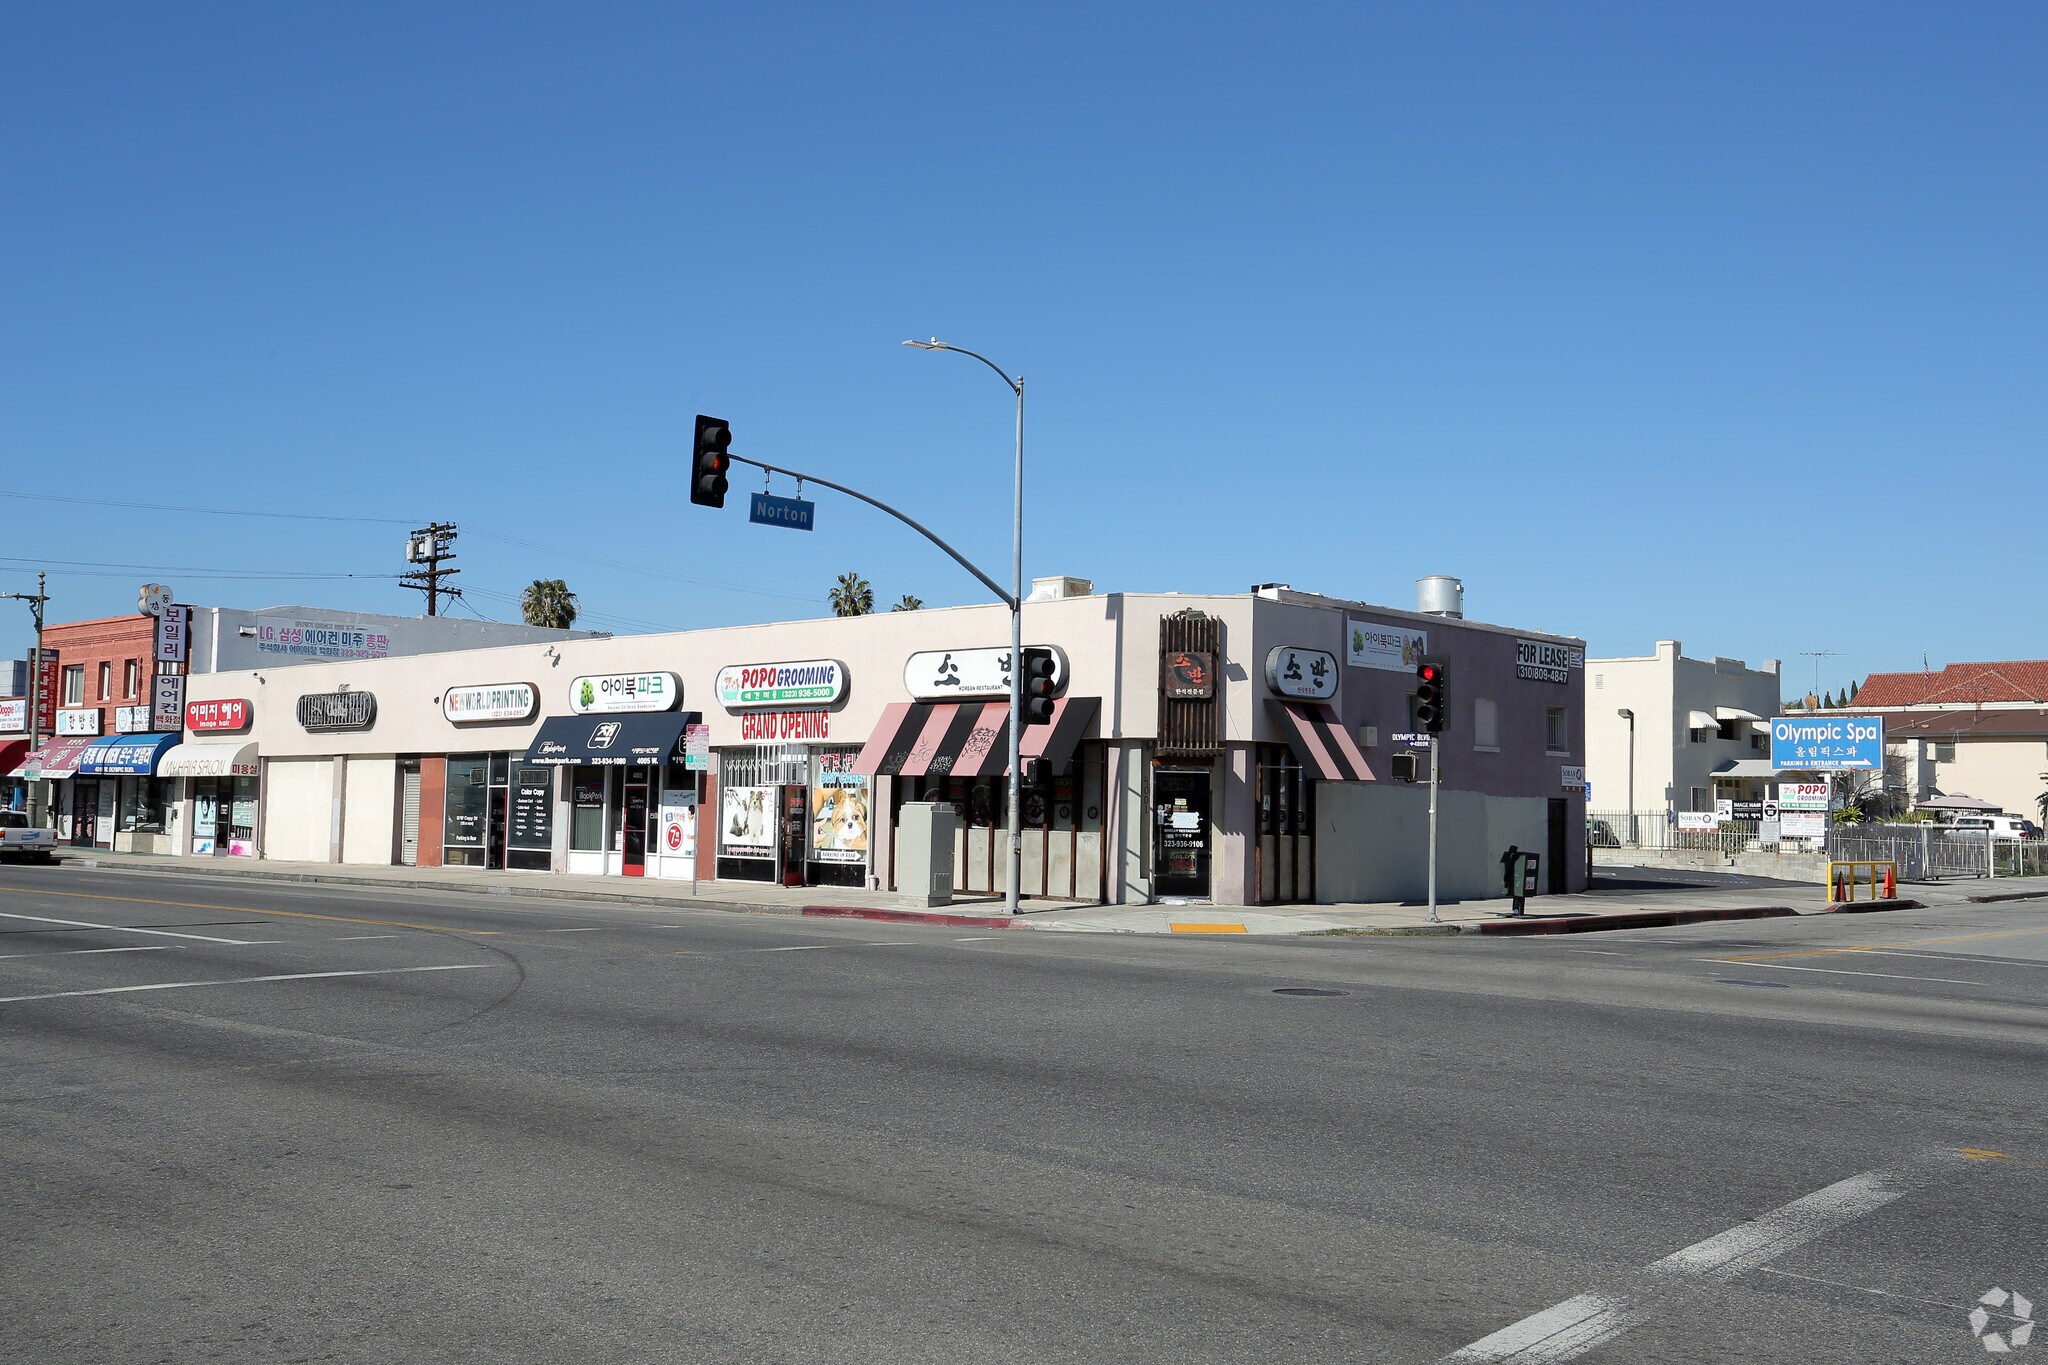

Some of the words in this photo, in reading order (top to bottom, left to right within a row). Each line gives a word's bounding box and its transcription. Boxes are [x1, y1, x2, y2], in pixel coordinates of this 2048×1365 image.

[757, 501, 807, 522] Norton
[163, 608, 181, 659] 보일러
[279, 627, 302, 643] 삼성
[305, 629, 339, 646] 에어컨
[341, 632, 363, 647] 미주
[366, 633, 388, 649] 총판
[1365, 631, 1402, 649] 아이북파크
[1517, 643, 1537, 664] FOR
[1539, 646, 1568, 669] LEASE
[601, 676, 663, 698] 아이북파크
[741, 667, 777, 689] POPO
[777, 665, 834, 687] GROOMING
[160, 677, 179, 714] 에어컨
[465, 691, 491, 710] WORLD
[491, 689, 529, 709] PRINTING
[781, 690, 797, 698] (323)
[798, 688, 830, 697] 936-5000
[156, 715, 180, 725] 백화점
[190, 703, 218, 721] 이미지
[221, 702, 242, 720] 헤어
[742, 712, 777, 740] GRAND
[781, 709, 828, 739] OPENING
[1775, 722, 1842, 744] Olympic
[1846, 722, 1877, 744] Spa
[596, 724, 615, 747] 책
[1392, 733, 1415, 741] OLYMPIC
[196, 760, 226, 775] SALON
[232, 764, 258, 775] 미용실
[821, 771, 837, 783] DAY
[839, 772, 863, 784] CARE
[520, 788, 533, 797] Color
[533, 788, 545, 797] Copy
[1797, 785, 1827, 795] POPO
[1163, 840, 1204, 849] 323-936-9106
